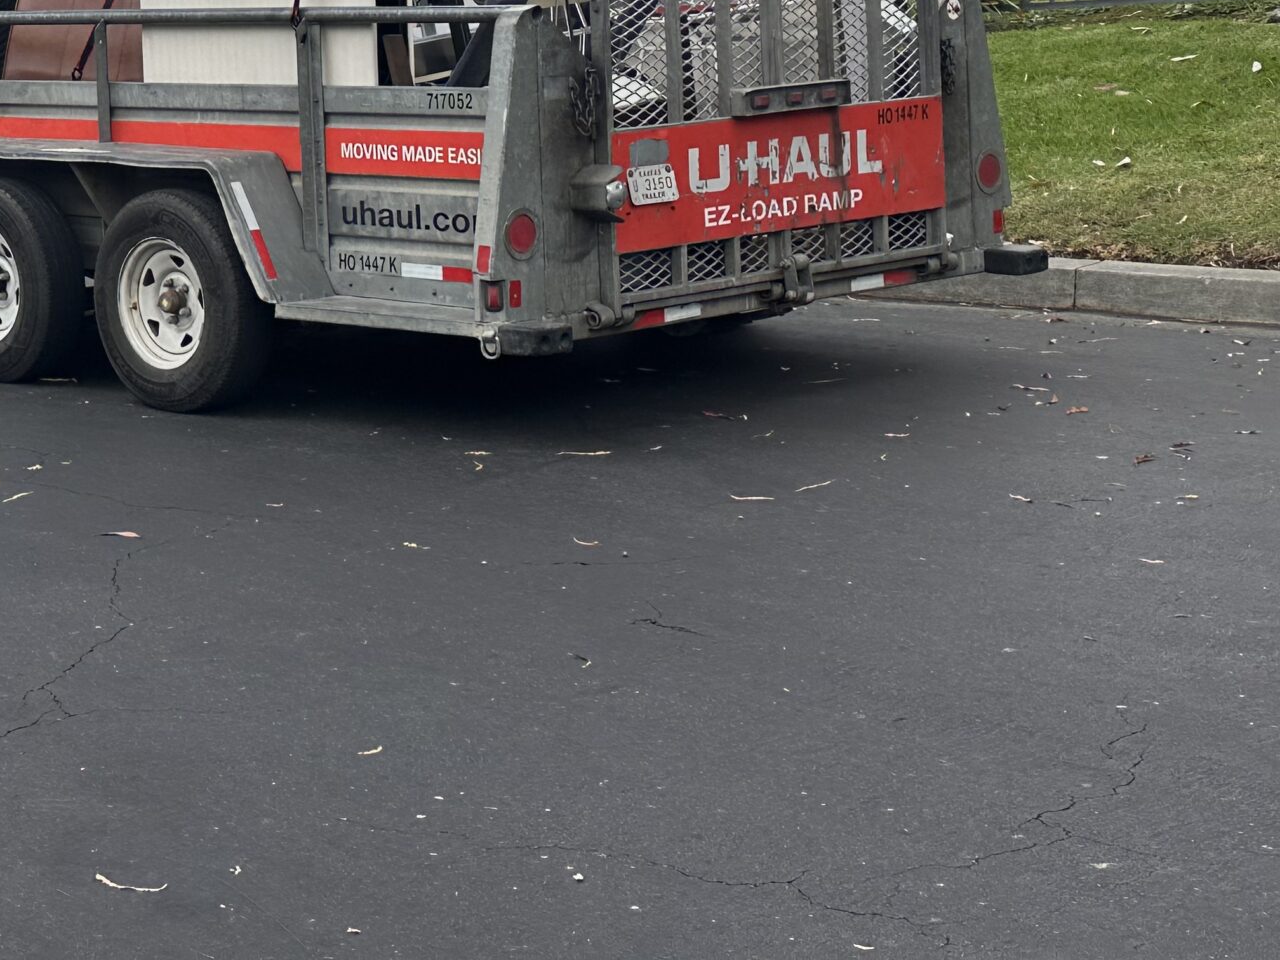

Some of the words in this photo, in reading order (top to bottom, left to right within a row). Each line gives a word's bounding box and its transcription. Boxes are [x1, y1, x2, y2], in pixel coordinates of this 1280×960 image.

[426, 93, 473, 110] 717052
[894, 104, 919, 123] 1447
[921, 103, 929, 120] K
[340, 142, 398, 161] MOVING
[402, 145, 444, 164] MADE
[644, 176, 673, 191] 3150
[341, 200, 476, 234] uhaul.co
[704, 196, 797, 227] EZ-LOAD
[804, 189, 863, 214] RAMP
[338, 252, 356, 272] HO
[359, 253, 386, 273] 1447
[389, 256, 398, 273] K
